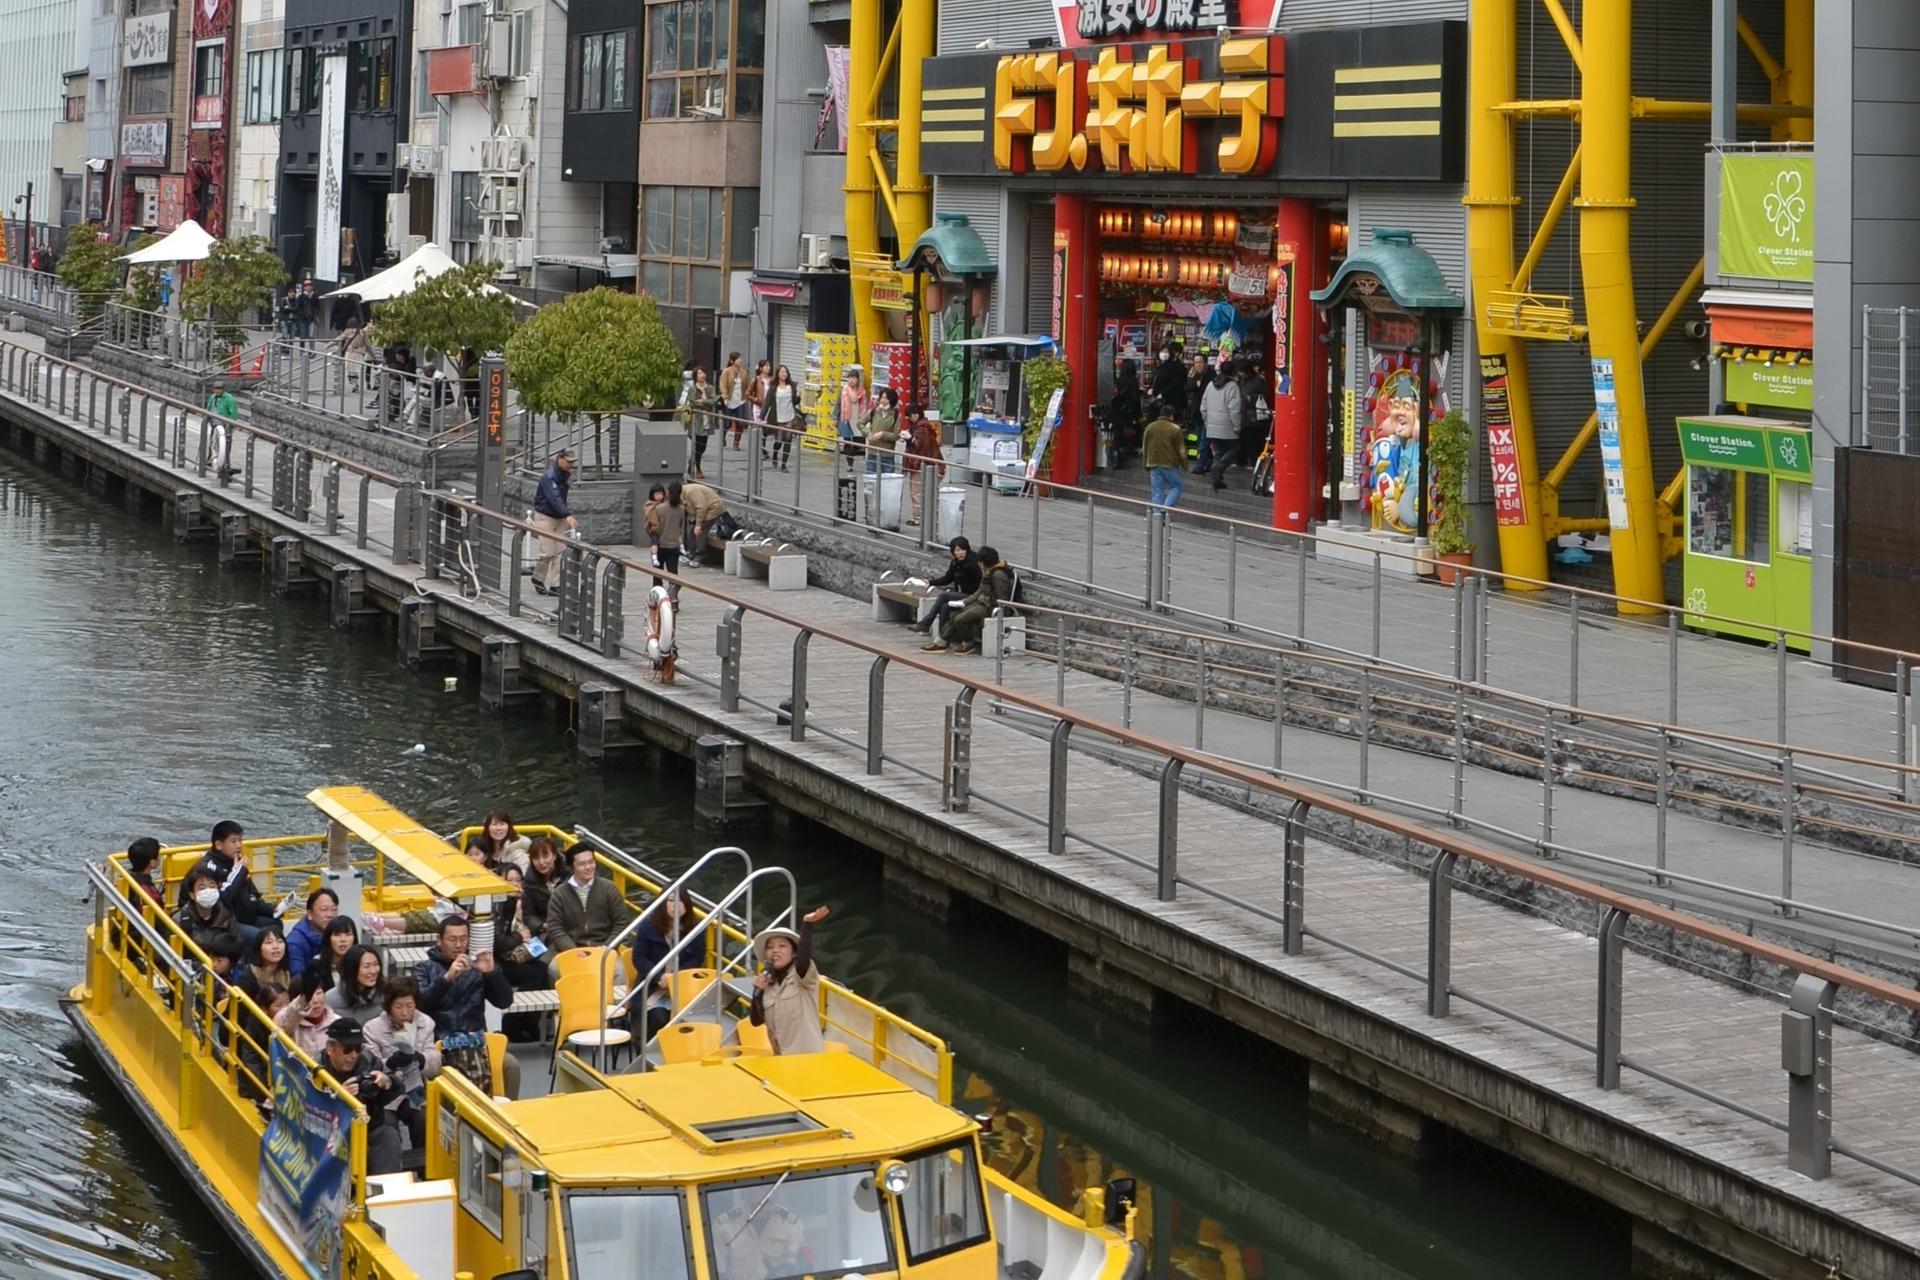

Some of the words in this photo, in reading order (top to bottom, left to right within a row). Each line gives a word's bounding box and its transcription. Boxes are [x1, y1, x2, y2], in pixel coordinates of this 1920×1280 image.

[1758, 245, 1782, 255] Clover
[1784, 247, 1813, 257] Station
[1752, 372, 1780, 383] Clover
[1782, 374, 1813, 386] Station
[1690, 432, 1719, 444] Clover
[1493, 483, 1518, 498] FF
